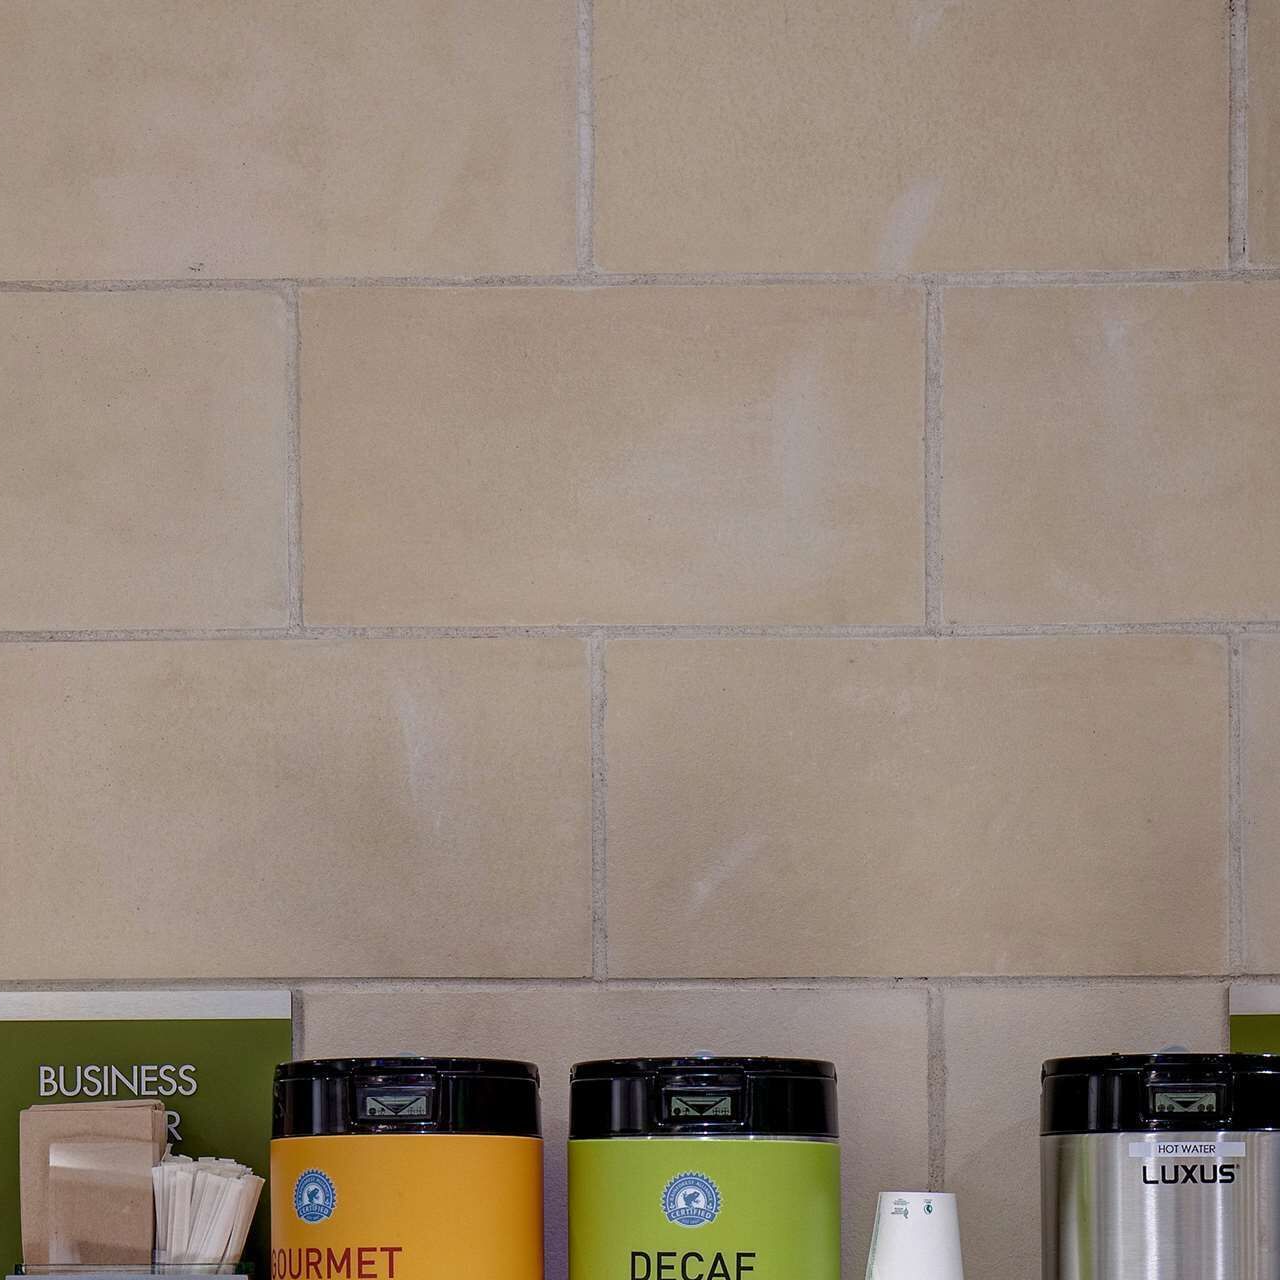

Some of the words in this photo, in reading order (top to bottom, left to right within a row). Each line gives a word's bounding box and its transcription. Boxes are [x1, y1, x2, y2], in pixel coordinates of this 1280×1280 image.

[39, 1064, 197, 1096] BUSINESS
[1158, 1144, 1179, 1154] HOT
[1181, 1144, 1216, 1154] WATER
[1142, 1164, 1235, 1184] LUXUS
[299, 1205, 329, 1215] CERTIFIED
[671, 1208, 712, 1219] CERTIFIED
